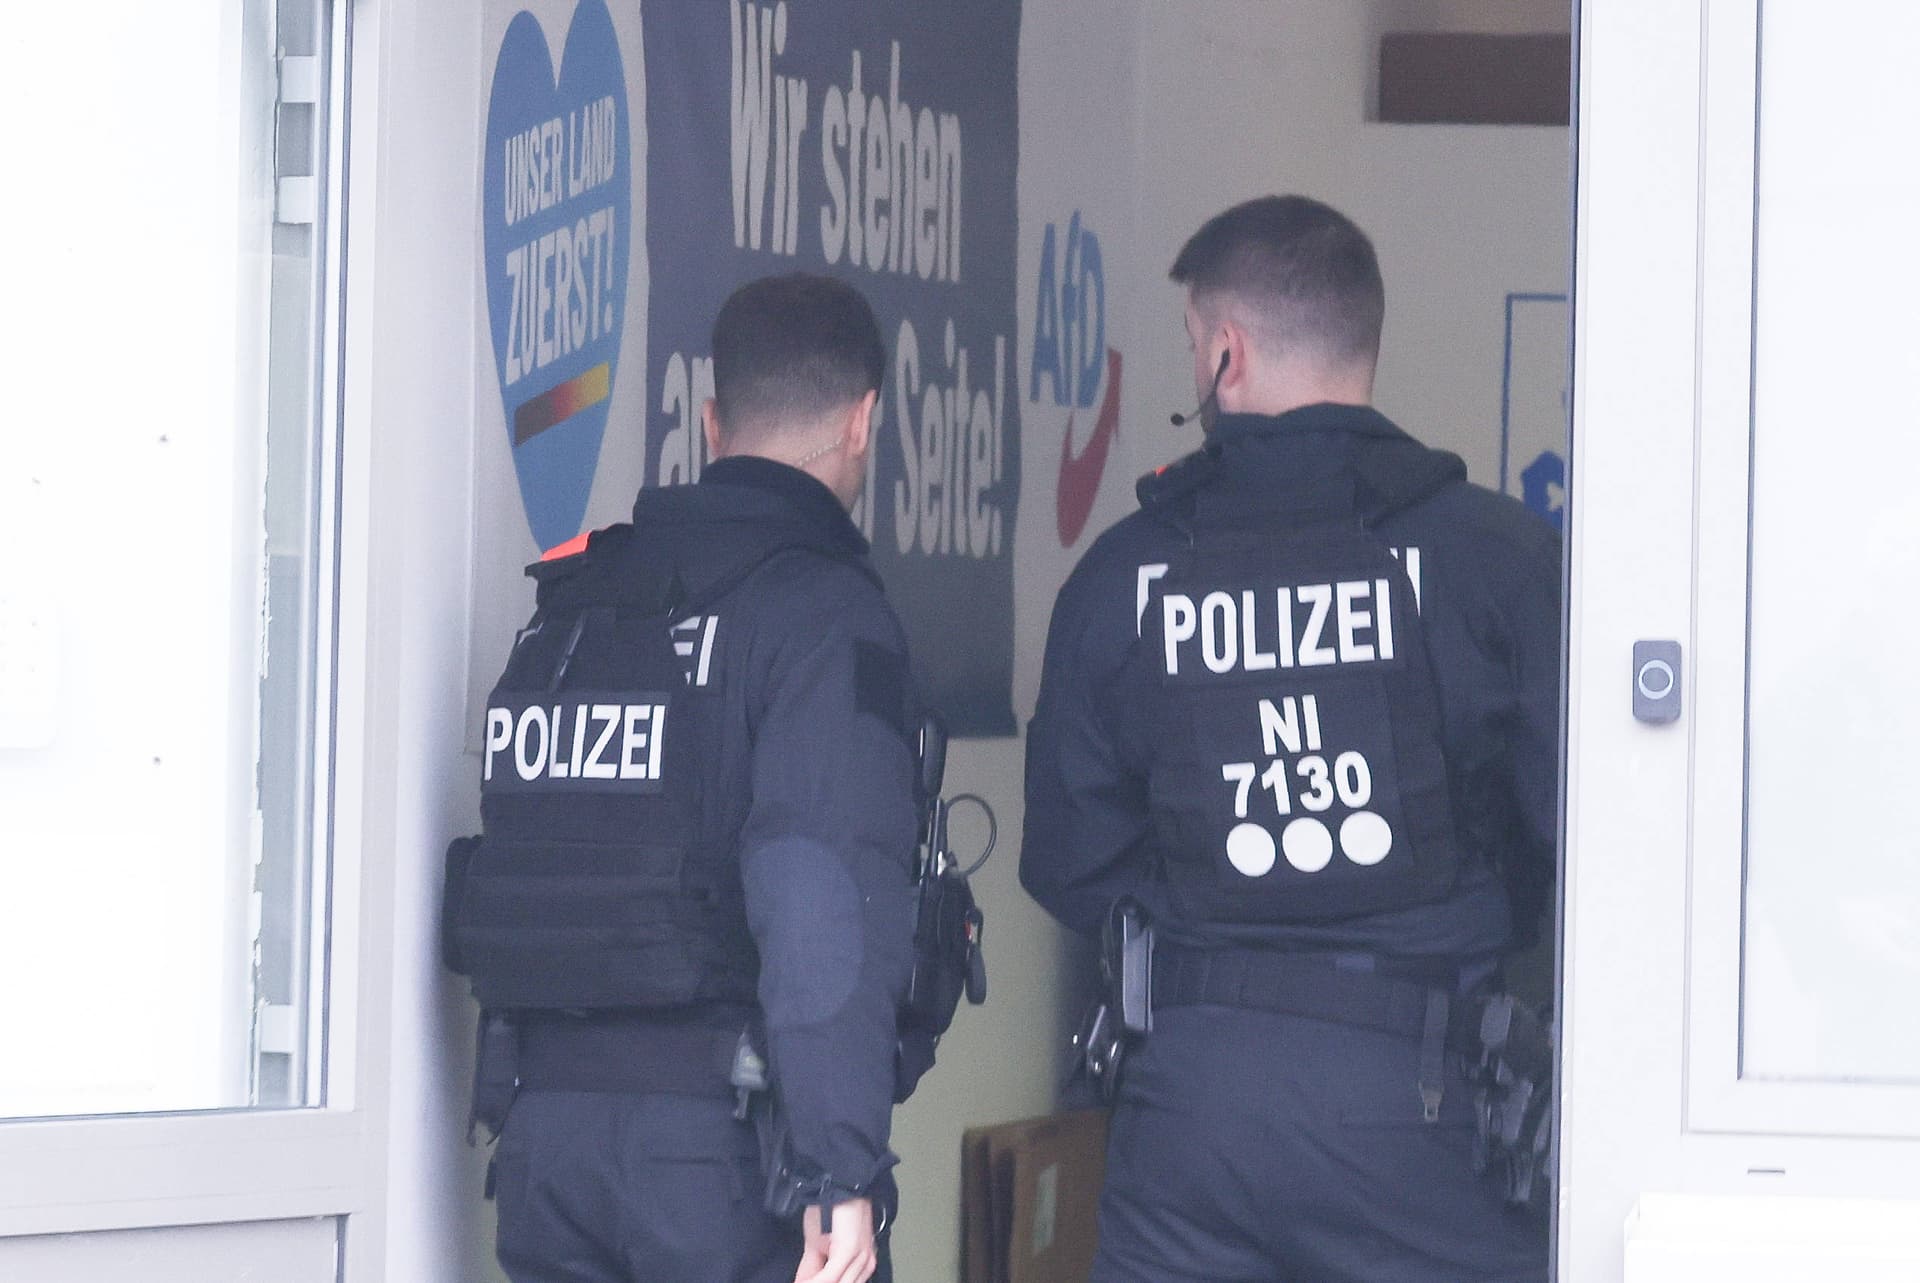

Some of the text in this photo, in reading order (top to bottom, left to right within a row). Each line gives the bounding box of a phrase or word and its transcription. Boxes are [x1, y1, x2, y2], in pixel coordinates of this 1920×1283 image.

[505, 95, 616, 226] UNSER LAND
[730, 0, 962, 283] Wir stehen
[505, 206, 615, 386] ZUERST!
[1029, 208, 1105, 409] AfD
[895, 318, 1006, 559] Seite!
[1162, 578, 1394, 675] POLIZEI
[484, 703, 666, 782] POLIZEI
[1222, 751, 1372, 818] 7130
[1258, 694, 1322, 755] NI
